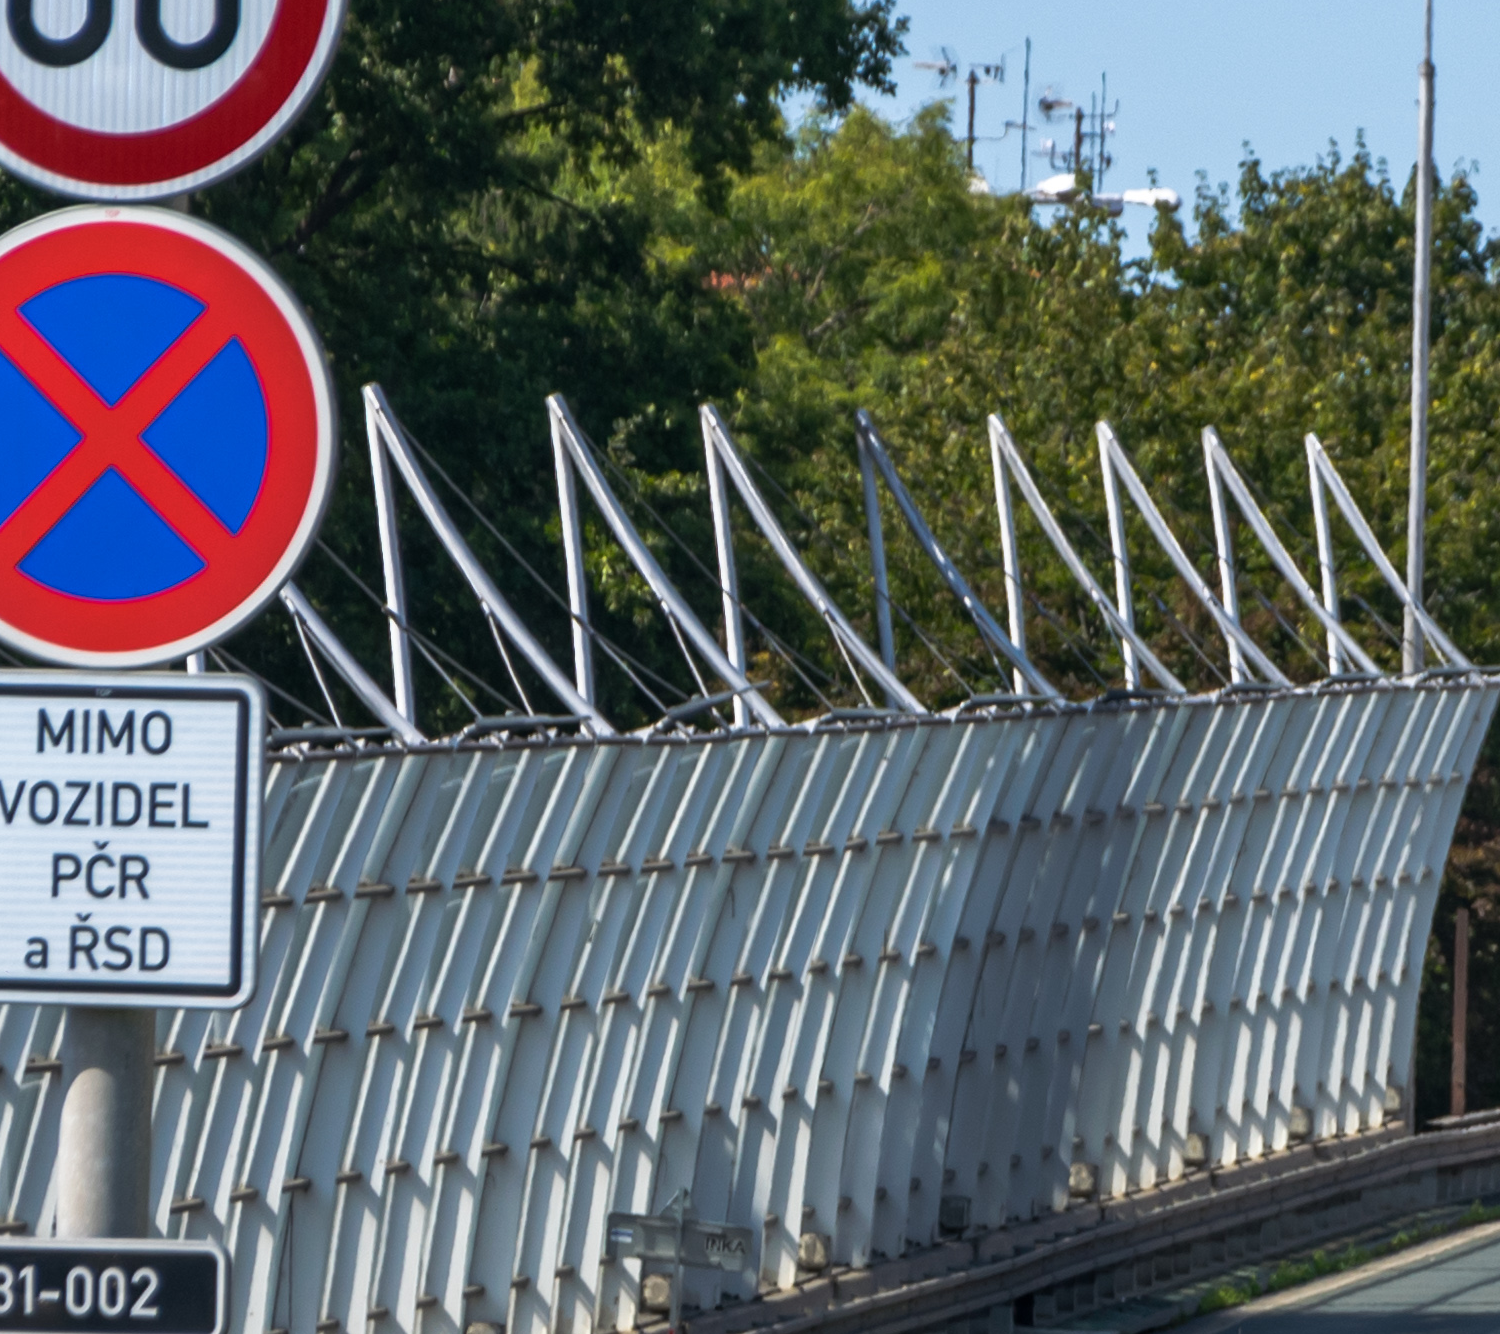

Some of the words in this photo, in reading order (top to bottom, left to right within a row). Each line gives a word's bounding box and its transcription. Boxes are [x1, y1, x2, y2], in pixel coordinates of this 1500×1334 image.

[36, 708, 174, 757] MIMO
[50, 840, 151, 901] PČR
[23, 936, 49, 970] a
[67, 912, 171, 973] ŘSD
